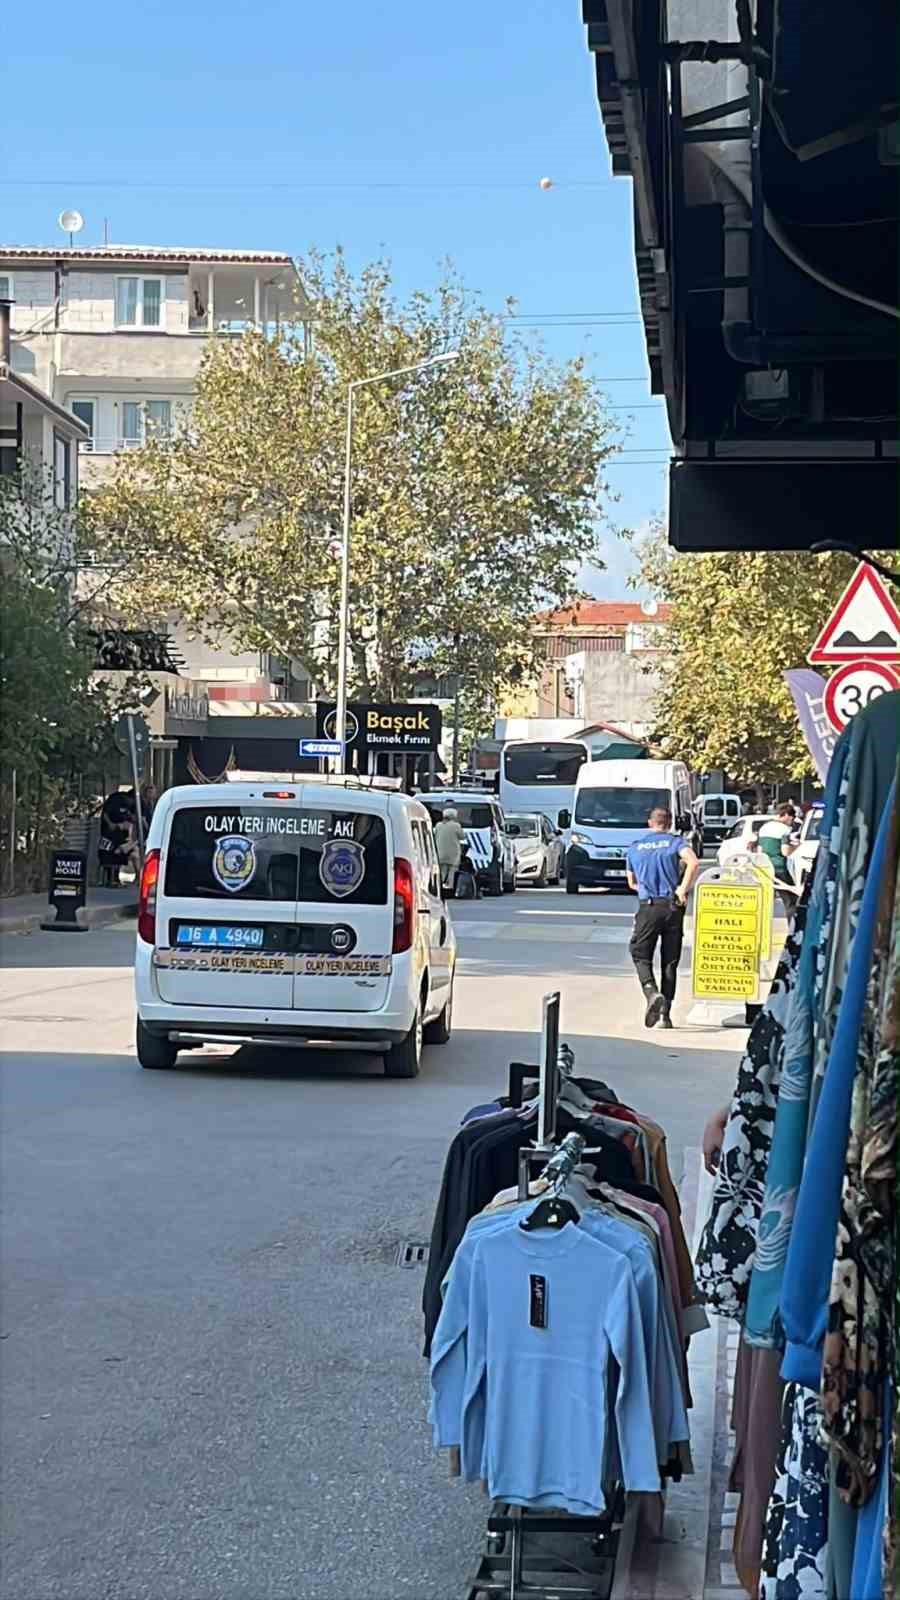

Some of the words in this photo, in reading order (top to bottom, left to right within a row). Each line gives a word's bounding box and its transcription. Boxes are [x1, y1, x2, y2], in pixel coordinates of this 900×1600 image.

[367, 711, 430, 733] Başak
[366, 733, 402, 744] Ekmek
[404, 733, 430, 745] Fırını
[205, 816, 235, 832] OLAY
[188, 927, 202, 941] 16
[208, 928, 218, 942] A
[225, 929, 261, 944] 4940
[211, 956, 230, 968] OLAY
[305, 960, 325, 971] OLAY
